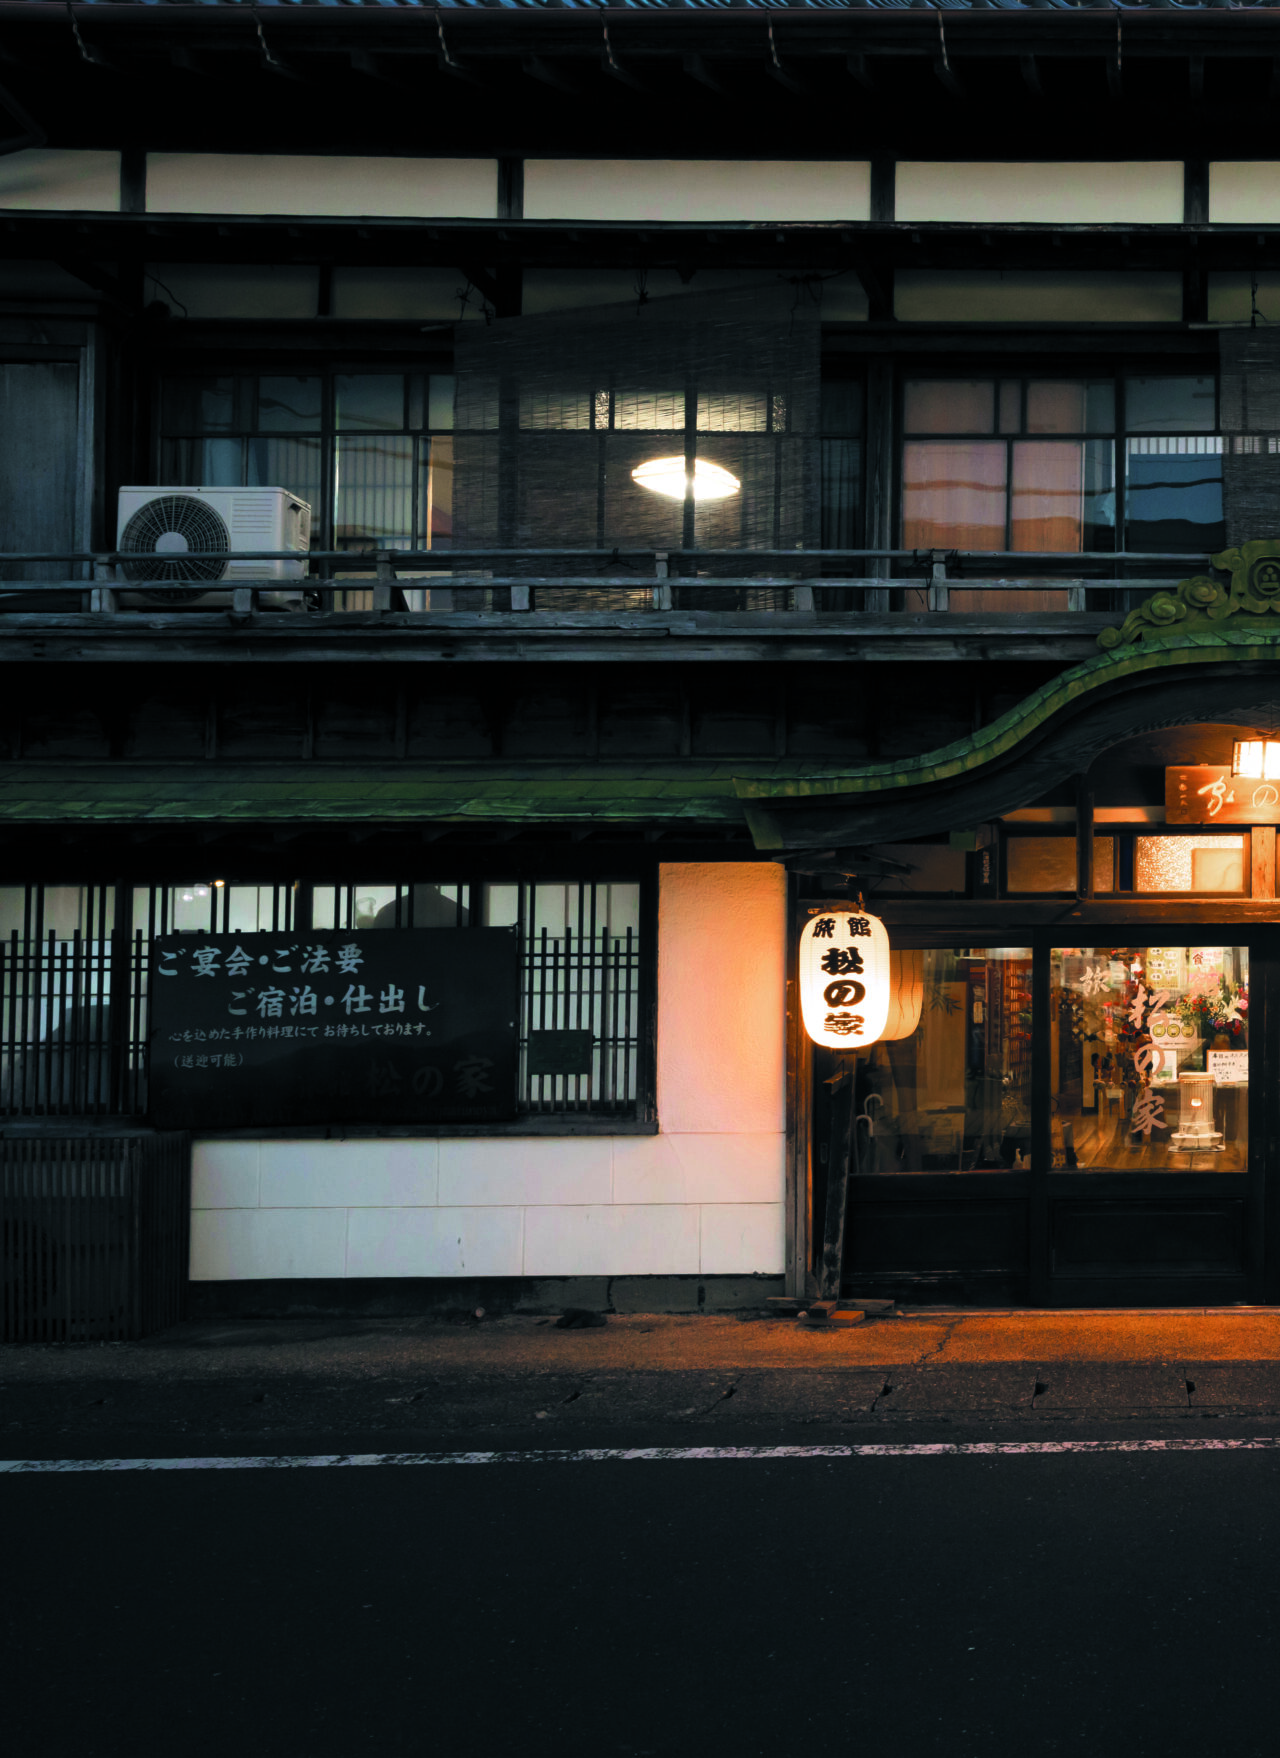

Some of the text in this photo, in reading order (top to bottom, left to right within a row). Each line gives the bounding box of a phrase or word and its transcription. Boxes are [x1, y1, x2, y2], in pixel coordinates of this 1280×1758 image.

[811, 916, 873, 939] 旅館
[158, 942, 366, 978] ご宴会・ご法要
[227, 983, 440, 1018] ご宿泊・仕出し
[820, 946, 867, 1037] 松の家
[168, 1022, 432, 1043] 心を込めた手作り料理にて お待ちしております。
[1128, 982, 1168, 1135] 松の家
[366, 1055, 496, 1099] 松の家
